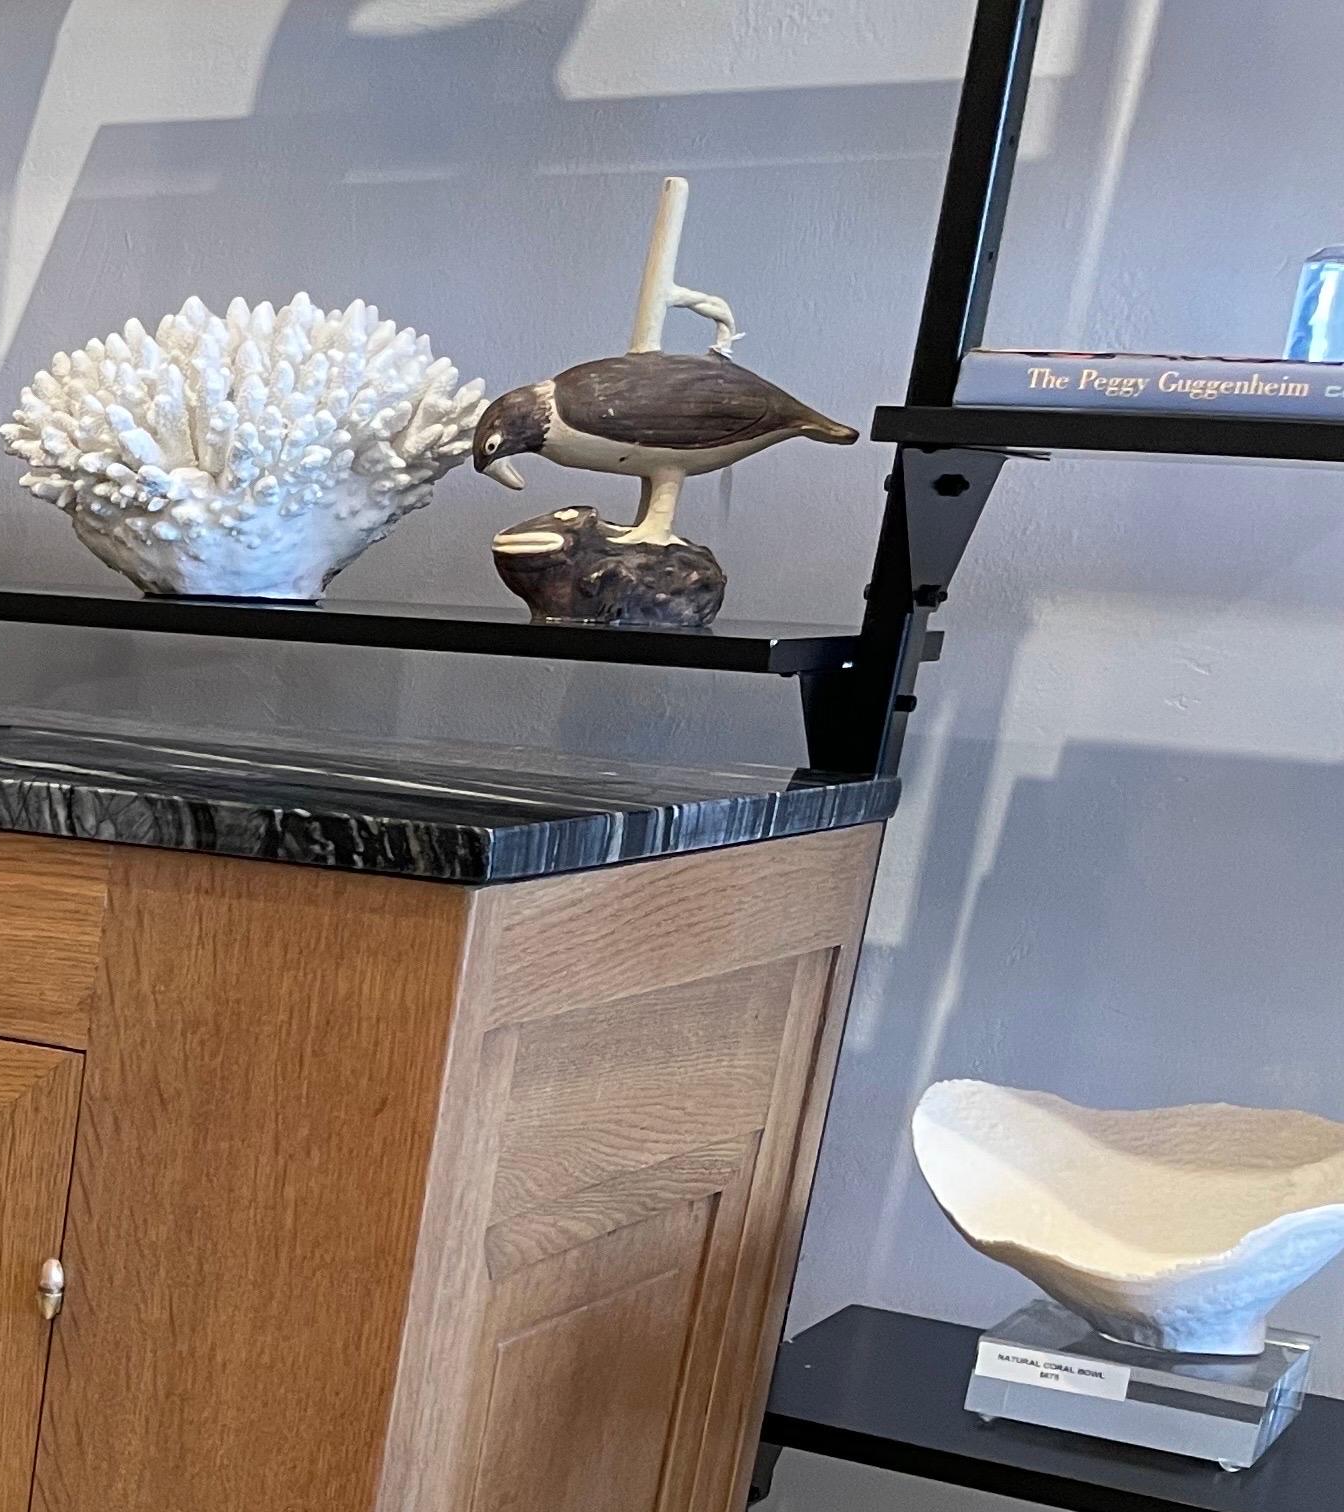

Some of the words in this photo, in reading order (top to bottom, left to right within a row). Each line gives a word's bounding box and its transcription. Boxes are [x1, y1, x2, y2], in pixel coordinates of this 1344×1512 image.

[1028, 368, 1070, 389] The
[1078, 369, 1150, 397] Peggy
[1158, 371, 1310, 399] Guggenheim
[998, 1353, 1041, 1368] NATURAL
[1043, 1361, 1075, 1374] CORAL
[1077, 1368, 1105, 1380] BOWL
